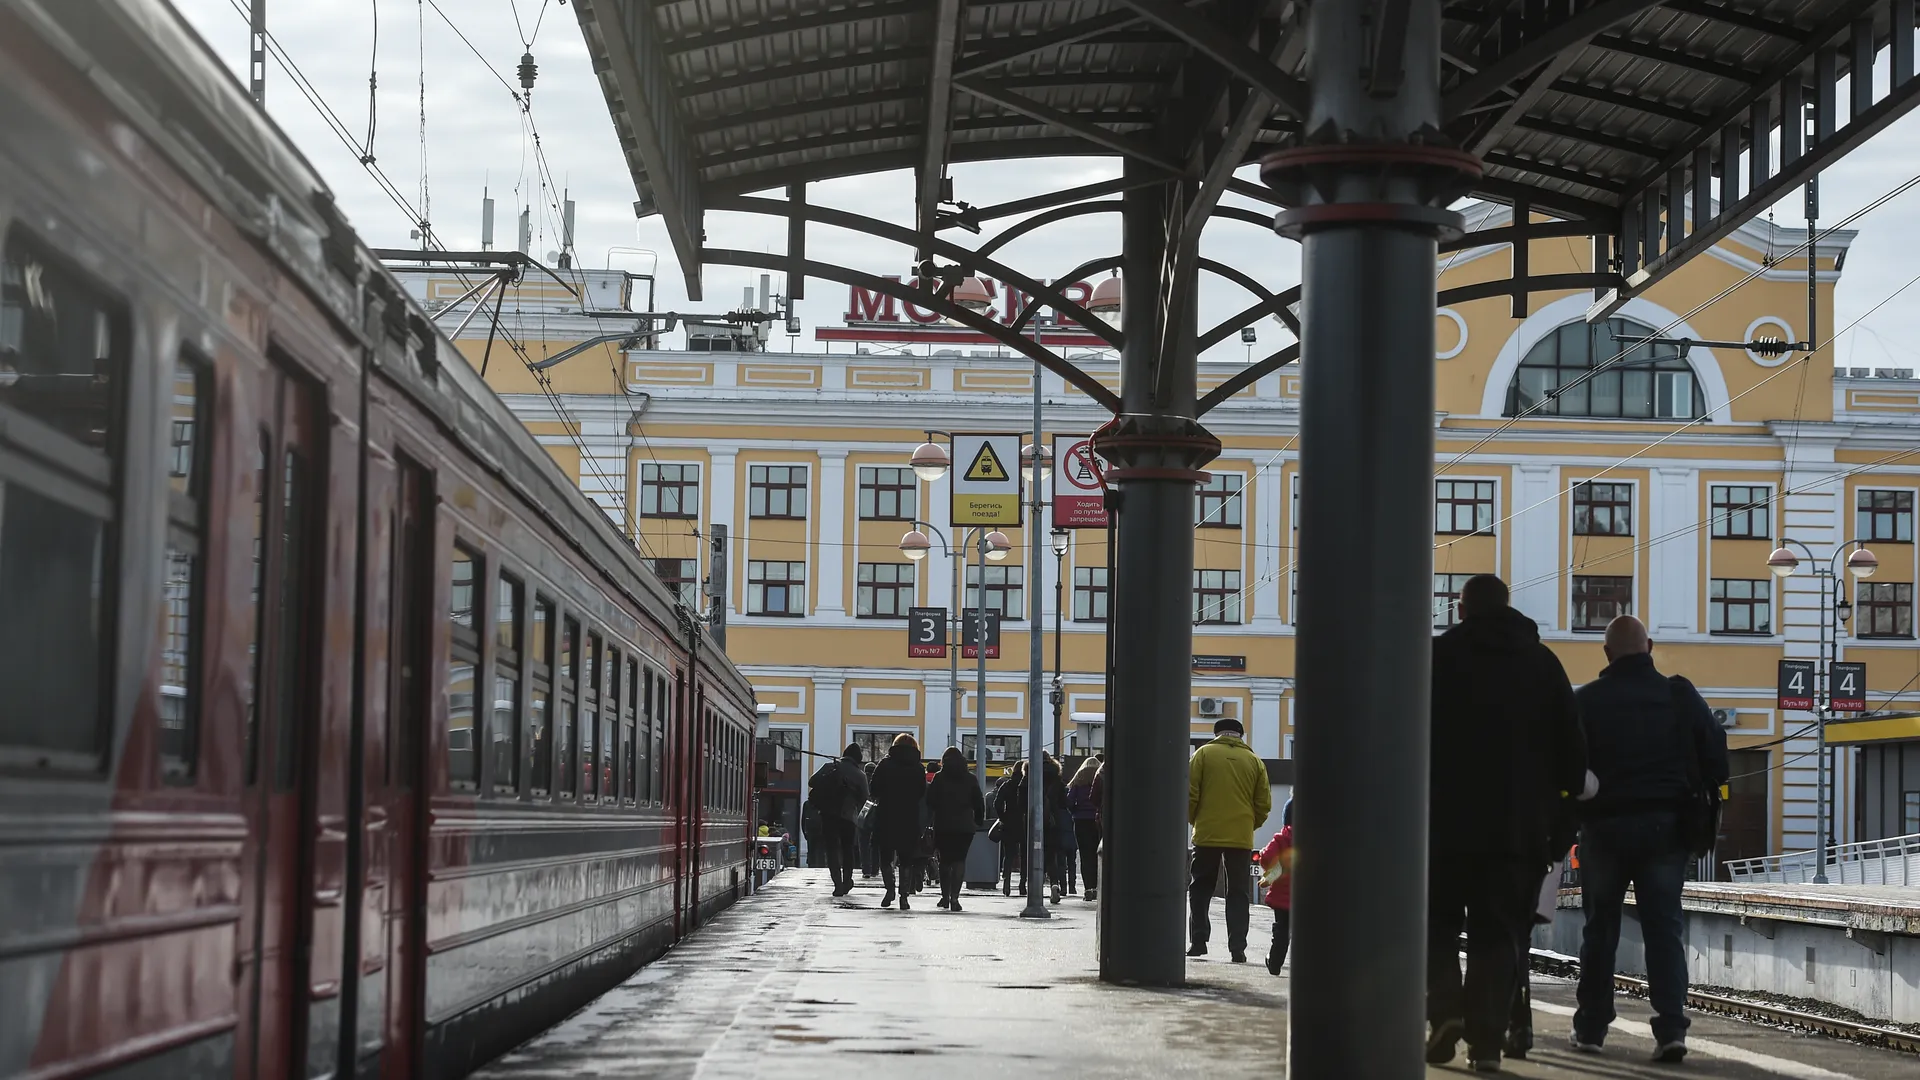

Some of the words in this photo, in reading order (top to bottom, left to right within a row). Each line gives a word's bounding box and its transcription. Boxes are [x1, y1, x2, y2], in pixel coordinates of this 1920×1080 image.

[969, 501, 1003, 510] Берегись
[920, 618, 935, 642] 3
[914, 647, 929, 655] Путь
[967, 648, 983, 656] Пут
[1788, 671, 1805, 695] 4
[1839, 672, 1857, 696] 4
